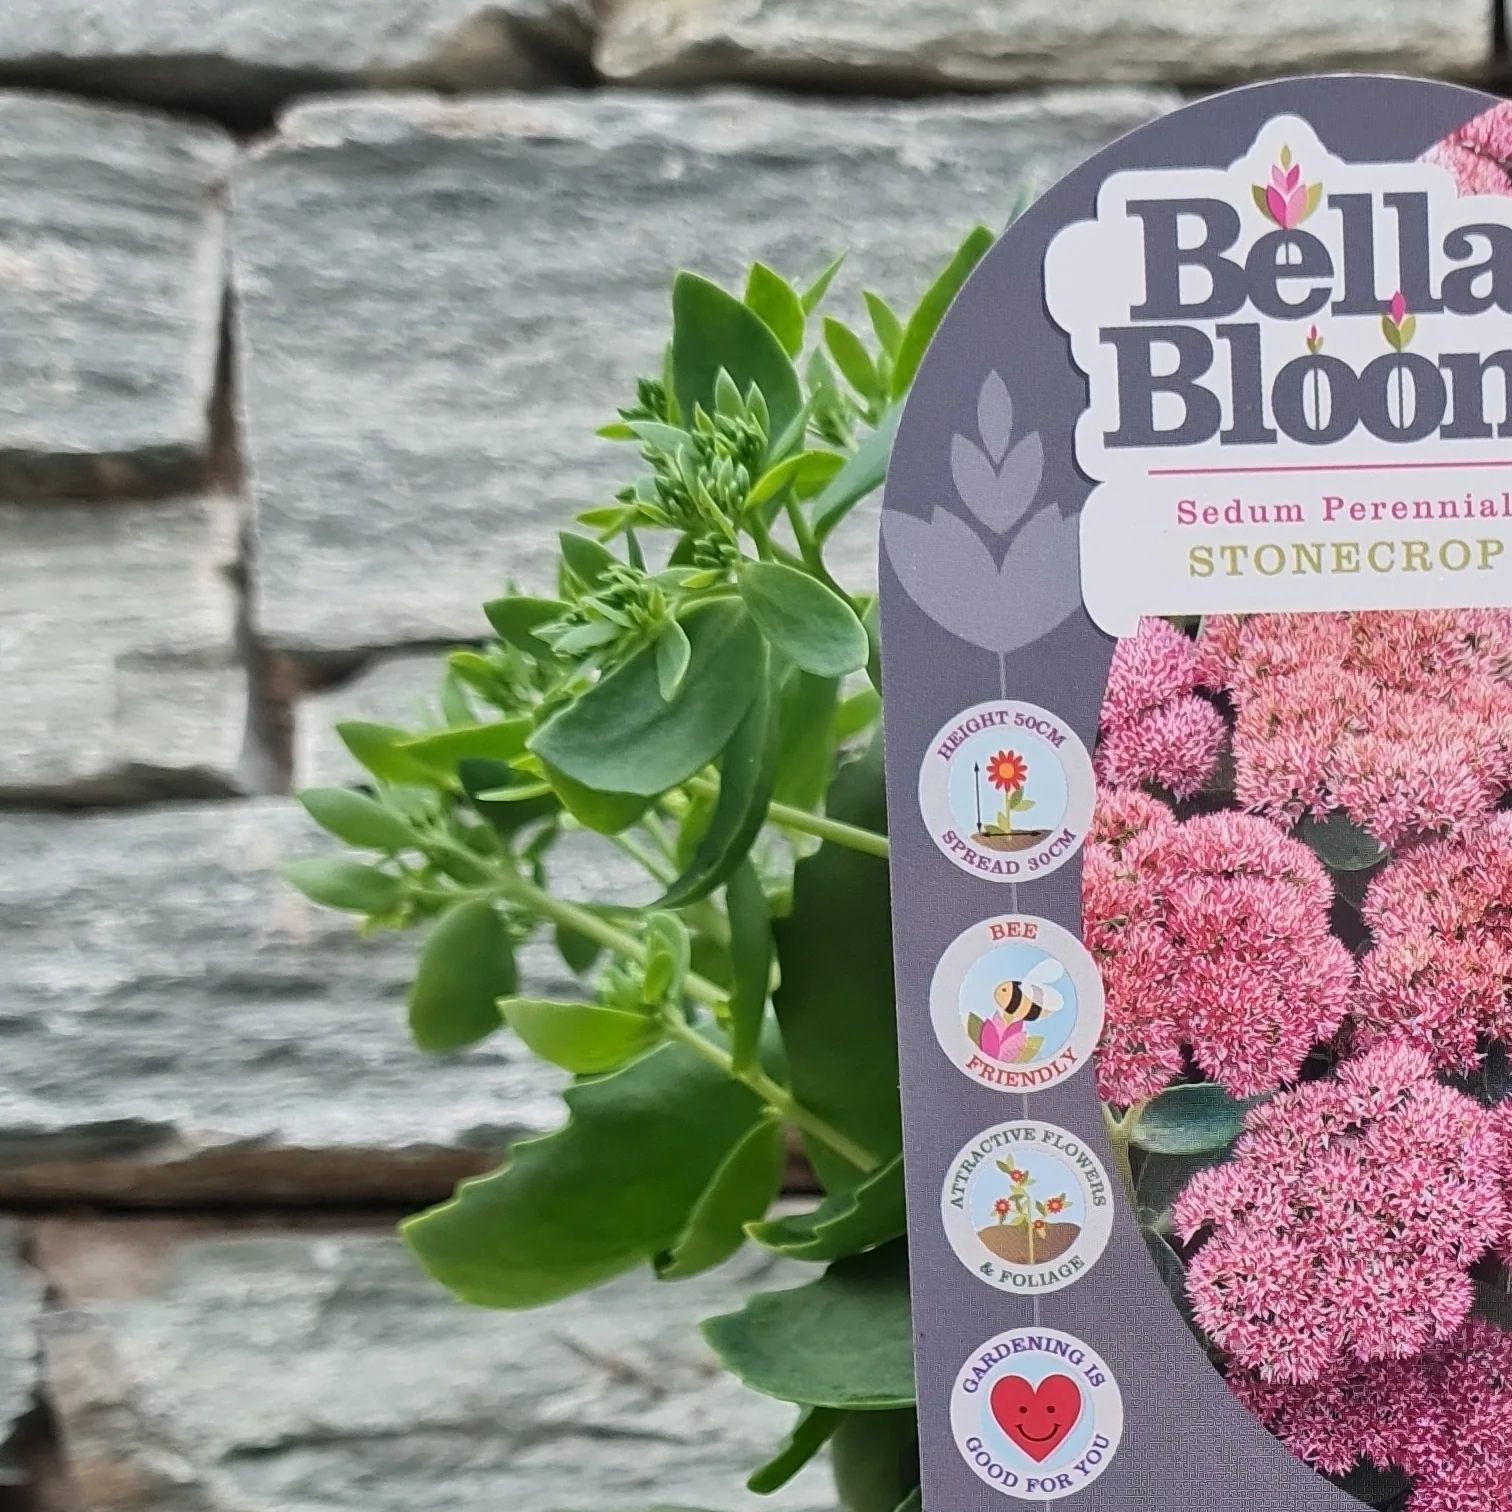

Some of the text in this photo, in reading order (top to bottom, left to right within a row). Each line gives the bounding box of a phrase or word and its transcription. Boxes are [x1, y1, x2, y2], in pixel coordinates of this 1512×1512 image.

[1177, 499, 1304, 526] Sedum
[1188, 539, 1505, 578] STONECROP
[937, 711, 1067, 762] HEIGHT 50CM
[941, 828, 1077, 876] SPREAD 30CM
[989, 922, 1038, 941] BEE
[965, 1047, 1080, 1088] FRIENDLY
[950, 1127, 1106, 1210] ATTRACTIVE FLOWERS
[979, 1255, 1085, 1287] & FOLIAGE
[963, 1336, 1106, 1395] GARDENING IS
[965, 1433, 1111, 1494] GOOD FOR YOU
